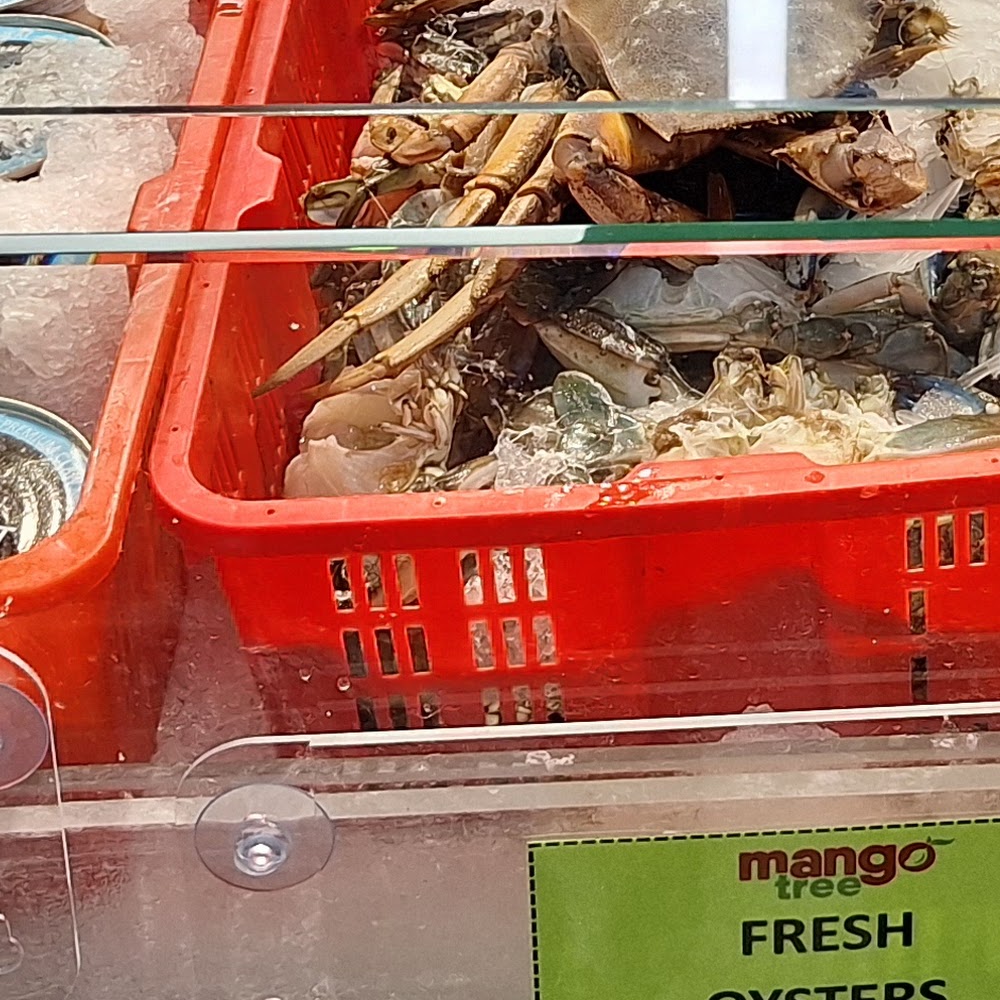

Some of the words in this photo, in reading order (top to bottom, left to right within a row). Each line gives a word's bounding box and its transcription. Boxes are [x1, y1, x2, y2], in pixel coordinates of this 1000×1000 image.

[739, 842, 937, 886] mango
[774, 875, 861, 900] tree
[741, 911, 913, 956] FRESH
